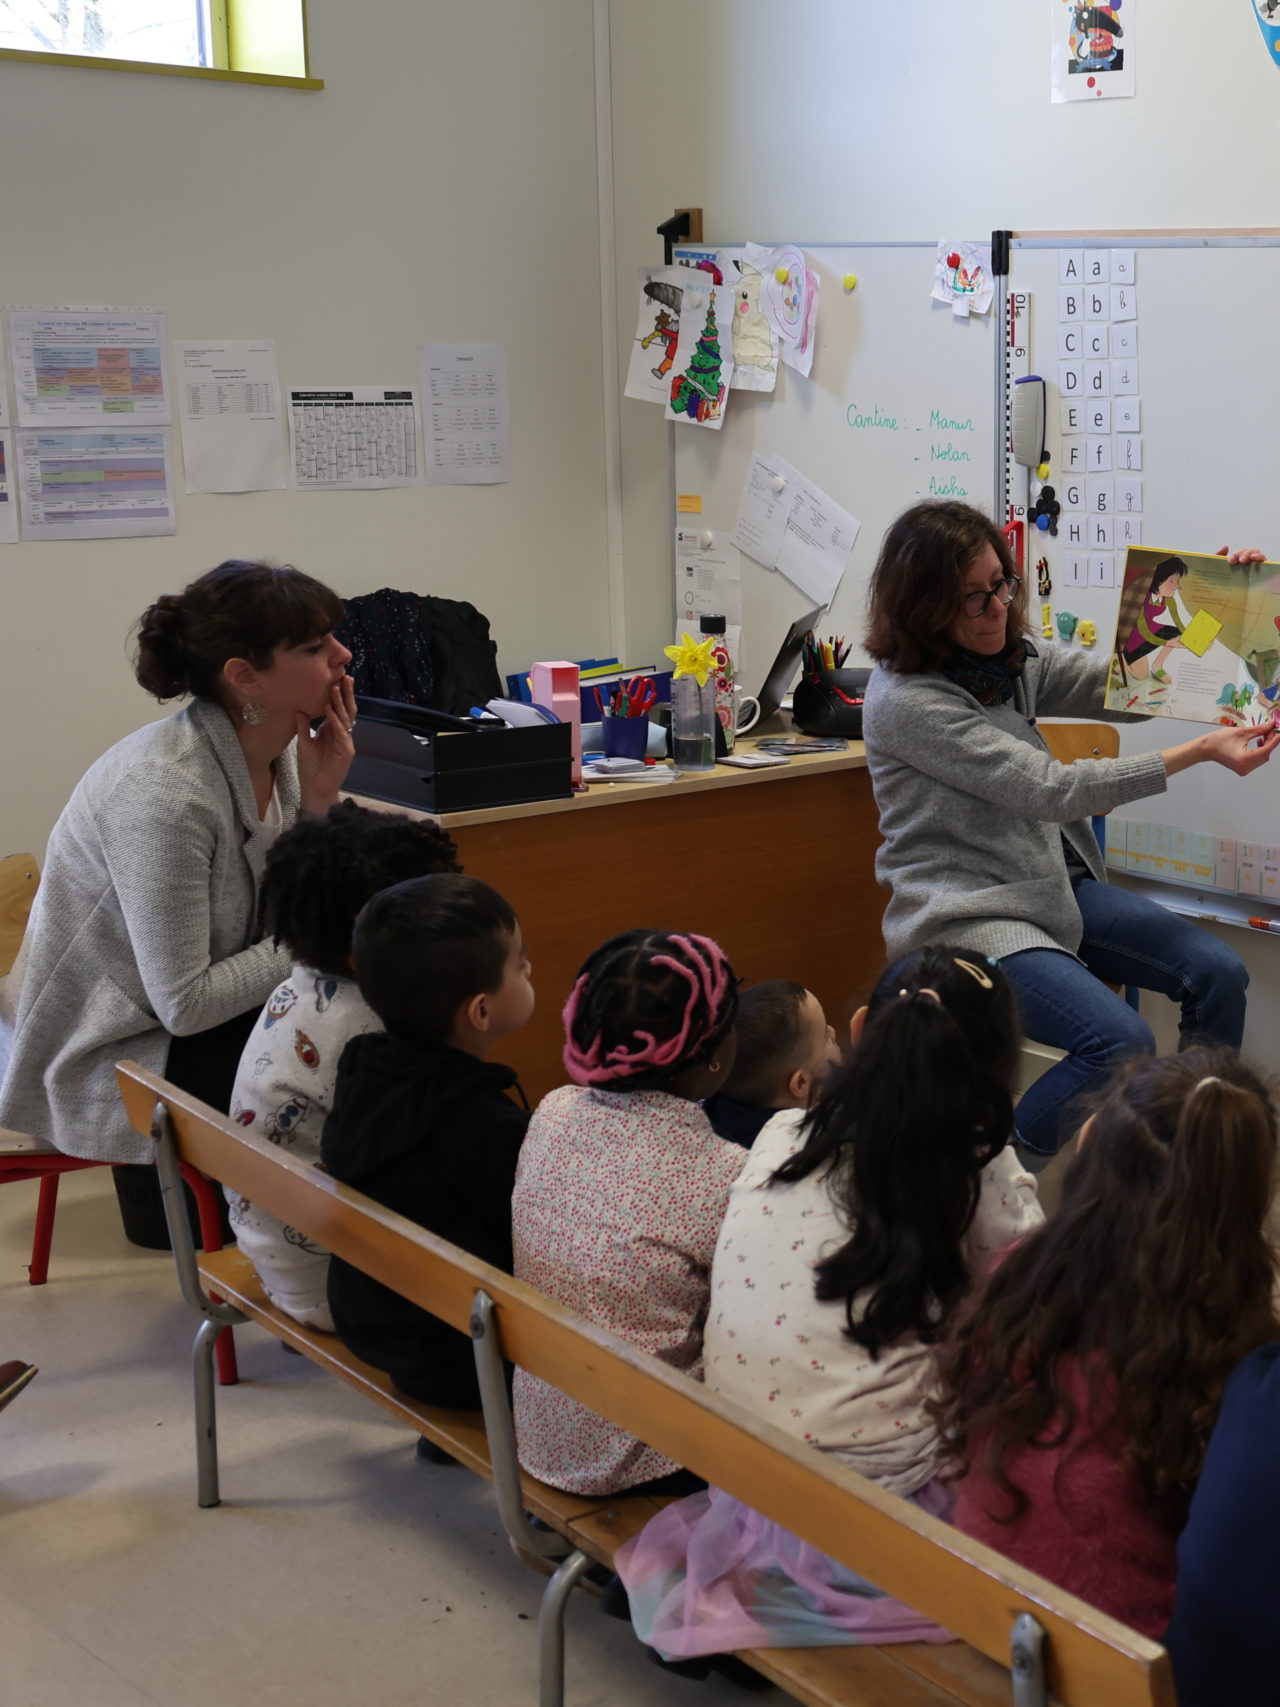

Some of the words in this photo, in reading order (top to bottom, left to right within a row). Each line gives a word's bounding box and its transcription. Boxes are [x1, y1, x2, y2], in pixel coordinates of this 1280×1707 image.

[1066, 259, 1076, 277] A
[1092, 262, 1100, 276] a
[1118, 264, 1127, 272] a
[1015, 294, 1026, 310] 10
[1067, 297, 1076, 314] B
[1092, 294, 1102, 313] b
[1120, 290, 1127, 309] b
[1066, 334, 1075, 351] C
[1092, 338, 1100, 352] c
[1121, 338, 1128, 346] c
[1066, 372, 1076, 389] D
[1093, 371, 1102, 389] d
[1121, 370, 1129, 384] d
[847, 404, 899, 430] Cantine
[1069, 409, 1077, 426] E
[1094, 413, 1103, 426] e
[931, 443, 971, 462] Nolan
[1071, 448, 1078, 465] F
[1097, 445, 1103, 464] f
[1127, 440, 1132, 469] f
[1068, 487, 1079, 504] G
[1097, 493, 1106, 511] g
[1126, 492, 1133, 512] g
[1070, 524, 1080, 542] H
[1097, 524, 1105, 542] h
[1125, 521, 1132, 539] h
